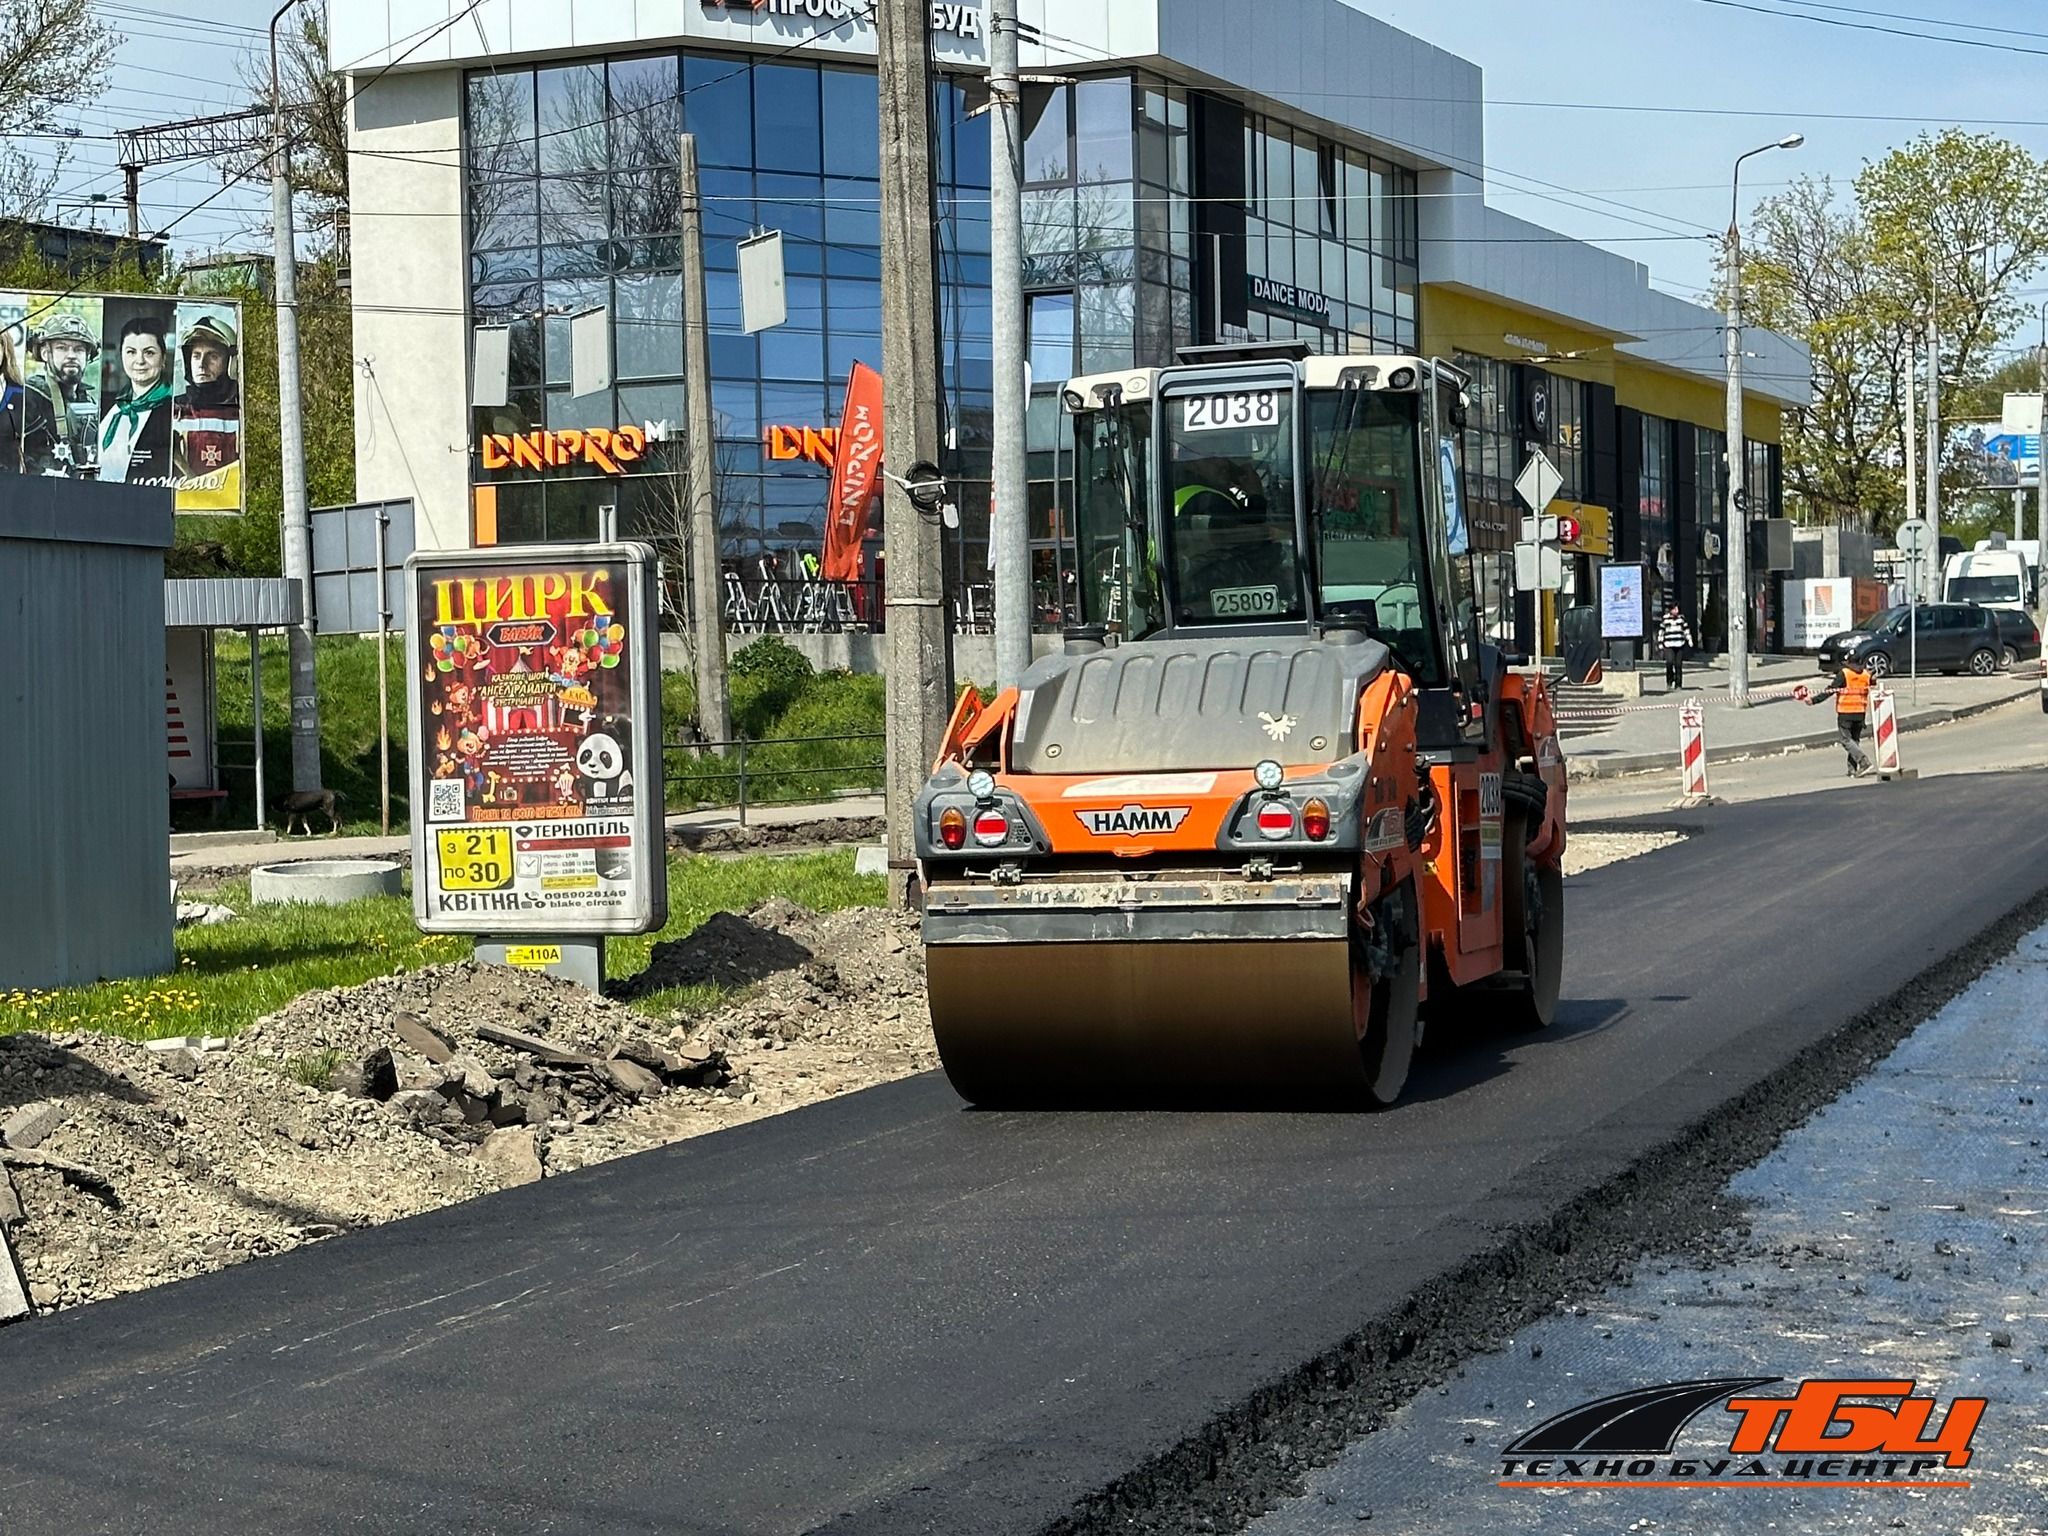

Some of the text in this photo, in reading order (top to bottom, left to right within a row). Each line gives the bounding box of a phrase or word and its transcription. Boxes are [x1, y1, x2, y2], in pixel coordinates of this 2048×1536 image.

[932, 3, 980, 39] БУД
[1254, 278, 1331, 315] DANCE MODA
[1188, 390, 1274, 427] 2038
[482, 424, 646, 474] DNIPRO
[432, 568, 615, 635] ЦИРК
[1216, 591, 1275, 614] 25809
[1093, 810, 1173, 832] HAMM
[466, 833, 497, 856] 21
[469, 862, 500, 883] 30
